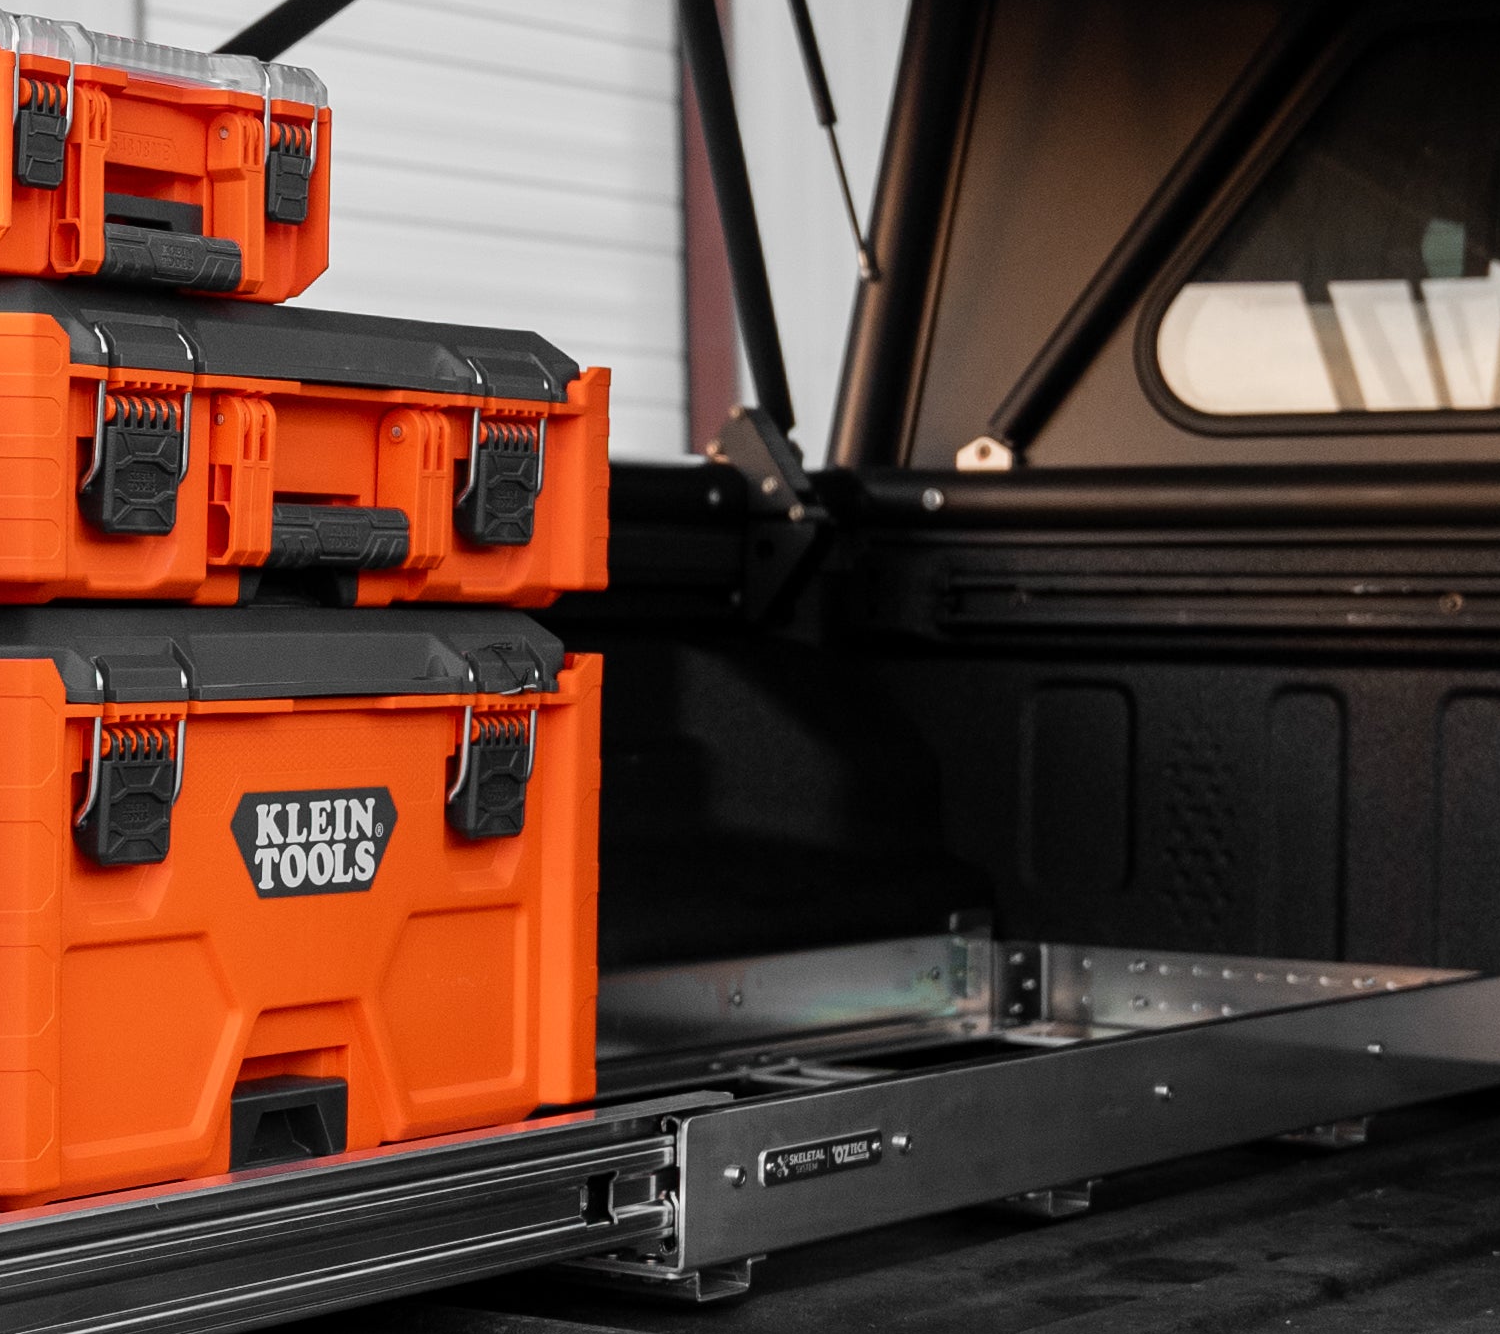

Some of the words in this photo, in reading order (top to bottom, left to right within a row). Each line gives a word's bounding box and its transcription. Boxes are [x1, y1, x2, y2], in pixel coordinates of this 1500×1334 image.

[256, 798, 376, 846] KLEIN
[254, 840, 376, 889] TOOLS
[789, 1148, 826, 1166] SKELETAL
[795, 1161, 818, 1174] SYSTEM
